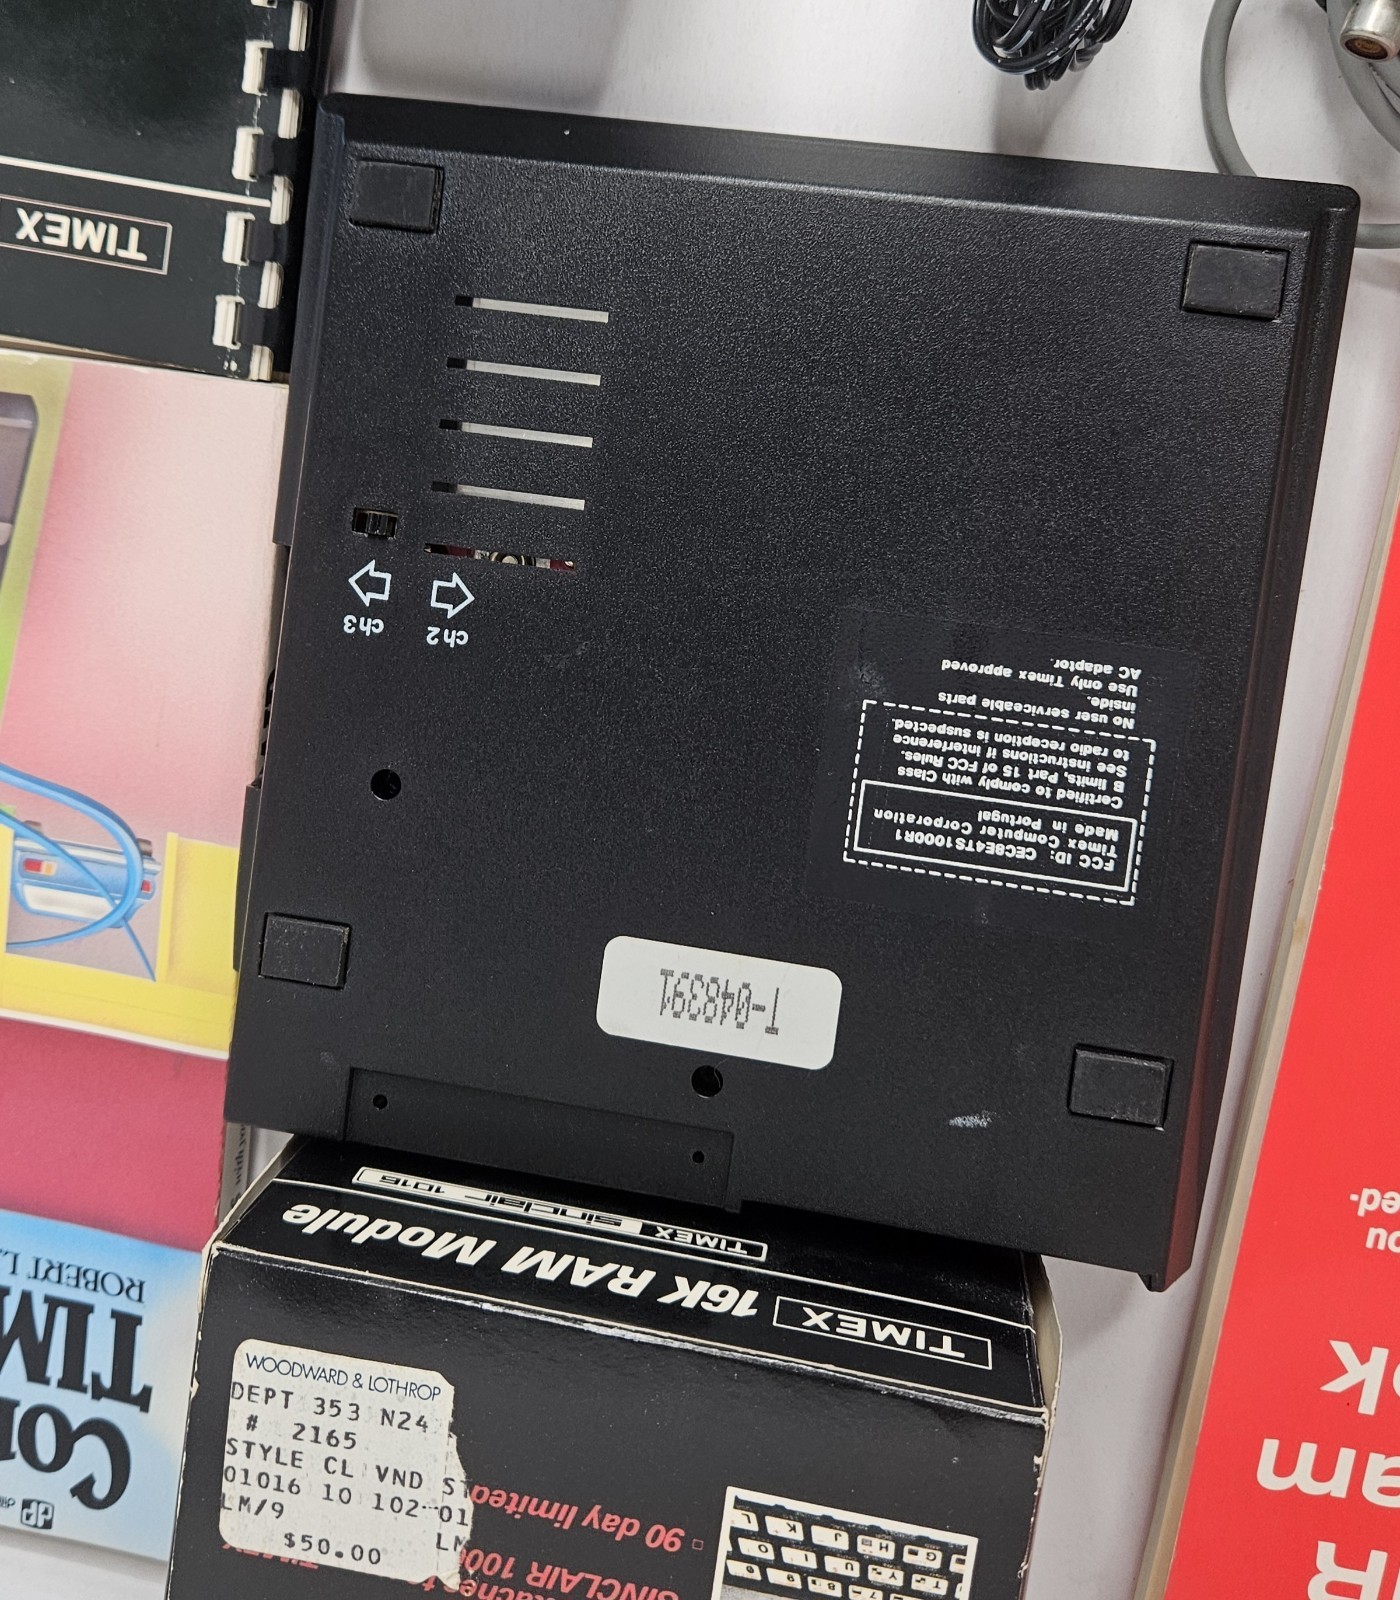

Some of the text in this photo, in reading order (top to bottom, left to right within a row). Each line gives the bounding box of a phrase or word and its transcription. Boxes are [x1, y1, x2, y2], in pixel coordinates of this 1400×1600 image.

[15, 207, 148, 262] TIMEX
[940, 658, 1138, 697] Use only Timex approved
[1049, 657, 1142, 680] AC adaptor.
[937, 691, 1135, 730] No user serviceable parts
[1086, 695, 1136, 714] inside.
[891, 717, 1129, 761] to radio reception is suspected.
[892, 733, 1127, 778] See instructions if interference
[897, 765, 1123, 809] Certified to comply with Class
[900, 749, 1125, 793] B limits, Part 15 of FCC Rules.
[873, 808, 1118, 858] Timex Computer Corporation
[976, 809, 1119, 842] Made in Portugal
[1049, 849, 1072, 865] ID:
[1078, 853, 1115, 872] FCC
[659, 968, 779, 1035] T-048391
[462, 1193, 622, 1226] sinclair
[650, 1224, 751, 1256] TIMEX
[27, 1256, 146, 1304] ROBERT
[281, 1203, 970, 1358] TIMEX 16K RAM Module
[245, 1352, 441, 1401] WOODWARD & LOTHROP
[228, 1380, 428, 1433] DEPT 353 N24
[245, 1413, 356, 1450] # 2165
[225, 1437, 303, 1469] STYLE
[323, 1455, 354, 1478] CL
[375, 1464, 423, 1489] VND
[220, 1465, 301, 1495] 01016
[322, 1483, 352, 1504] 10
[218, 1491, 284, 1519] LM/9
[580, 1505, 641, 1542] day
[645, 1524, 686, 1552] 90
[786, 1523, 797, 1534] K
[834, 1532, 842, 1542] J
[283, 1531, 381, 1565] $50.00
[880, 1542, 889, 1552] H
[925, 1551, 937, 1562] G
[845, 1562, 854, 1571] U
[889, 1571, 897, 1581] Y
[932, 1580, 941, 1589] T
